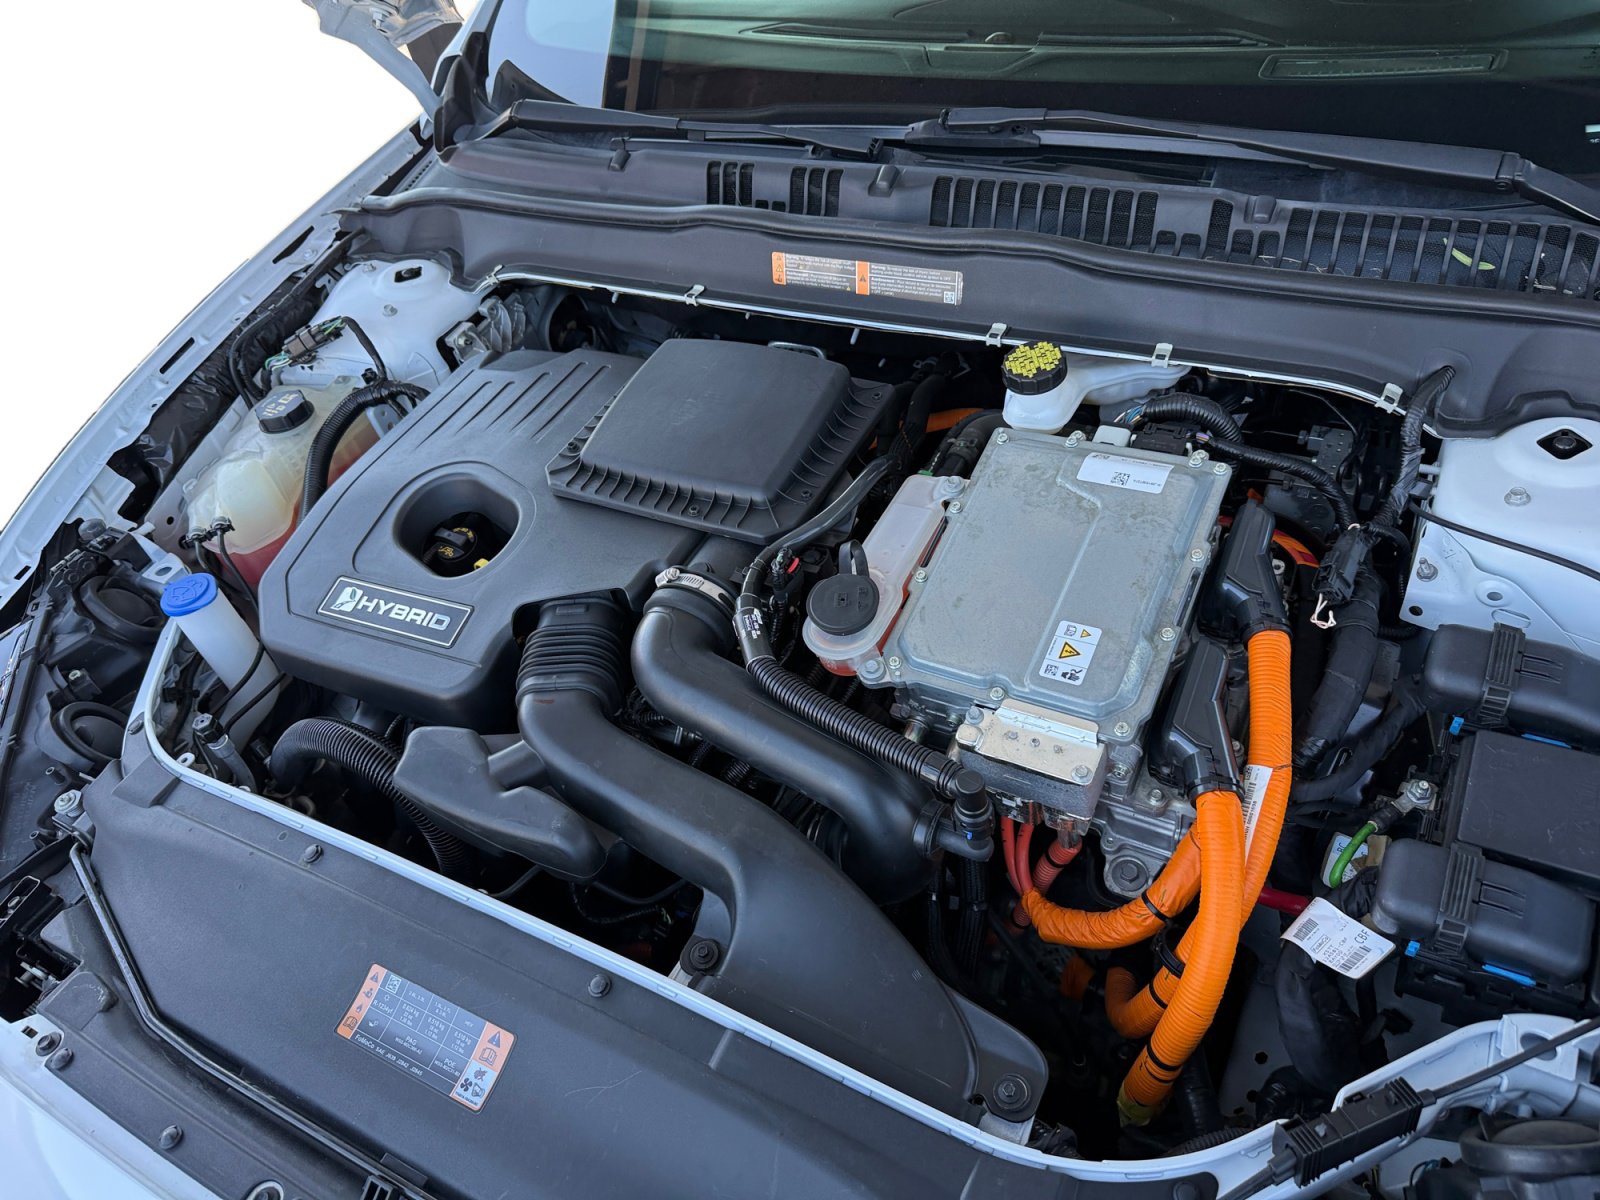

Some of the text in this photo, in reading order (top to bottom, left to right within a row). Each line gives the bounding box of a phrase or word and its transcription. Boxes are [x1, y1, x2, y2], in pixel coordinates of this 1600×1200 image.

[357, 595, 451, 631] HYBRID
[1354, 929, 1370, 944] CBF
[373, 999, 393, 1014] R-1234yf
[355, 1033, 375, 1048] FoMoCo
[376, 1046, 385, 1055] SAE
[405, 1035, 417, 1046] PAG
[444, 1058, 456, 1069] POE
